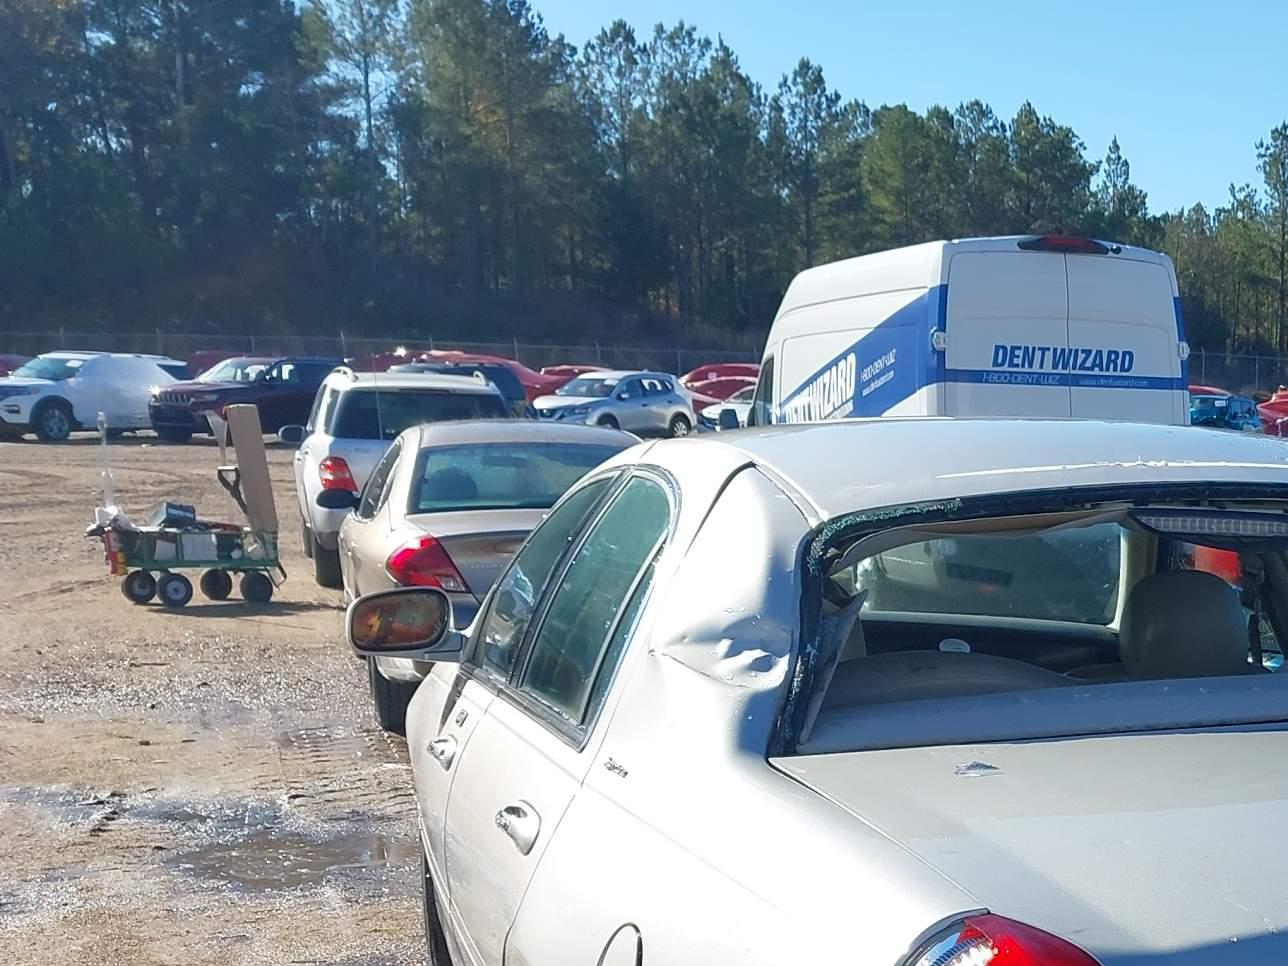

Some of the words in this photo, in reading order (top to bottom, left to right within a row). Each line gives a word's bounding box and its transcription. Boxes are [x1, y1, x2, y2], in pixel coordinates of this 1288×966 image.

[992, 343, 1051, 369] DENT
[1052, 347, 1135, 373] WIZARD
[808, 352, 856, 423] WIZARD
[982, 372, 1060, 385] 1-800-DENT-WIZ
